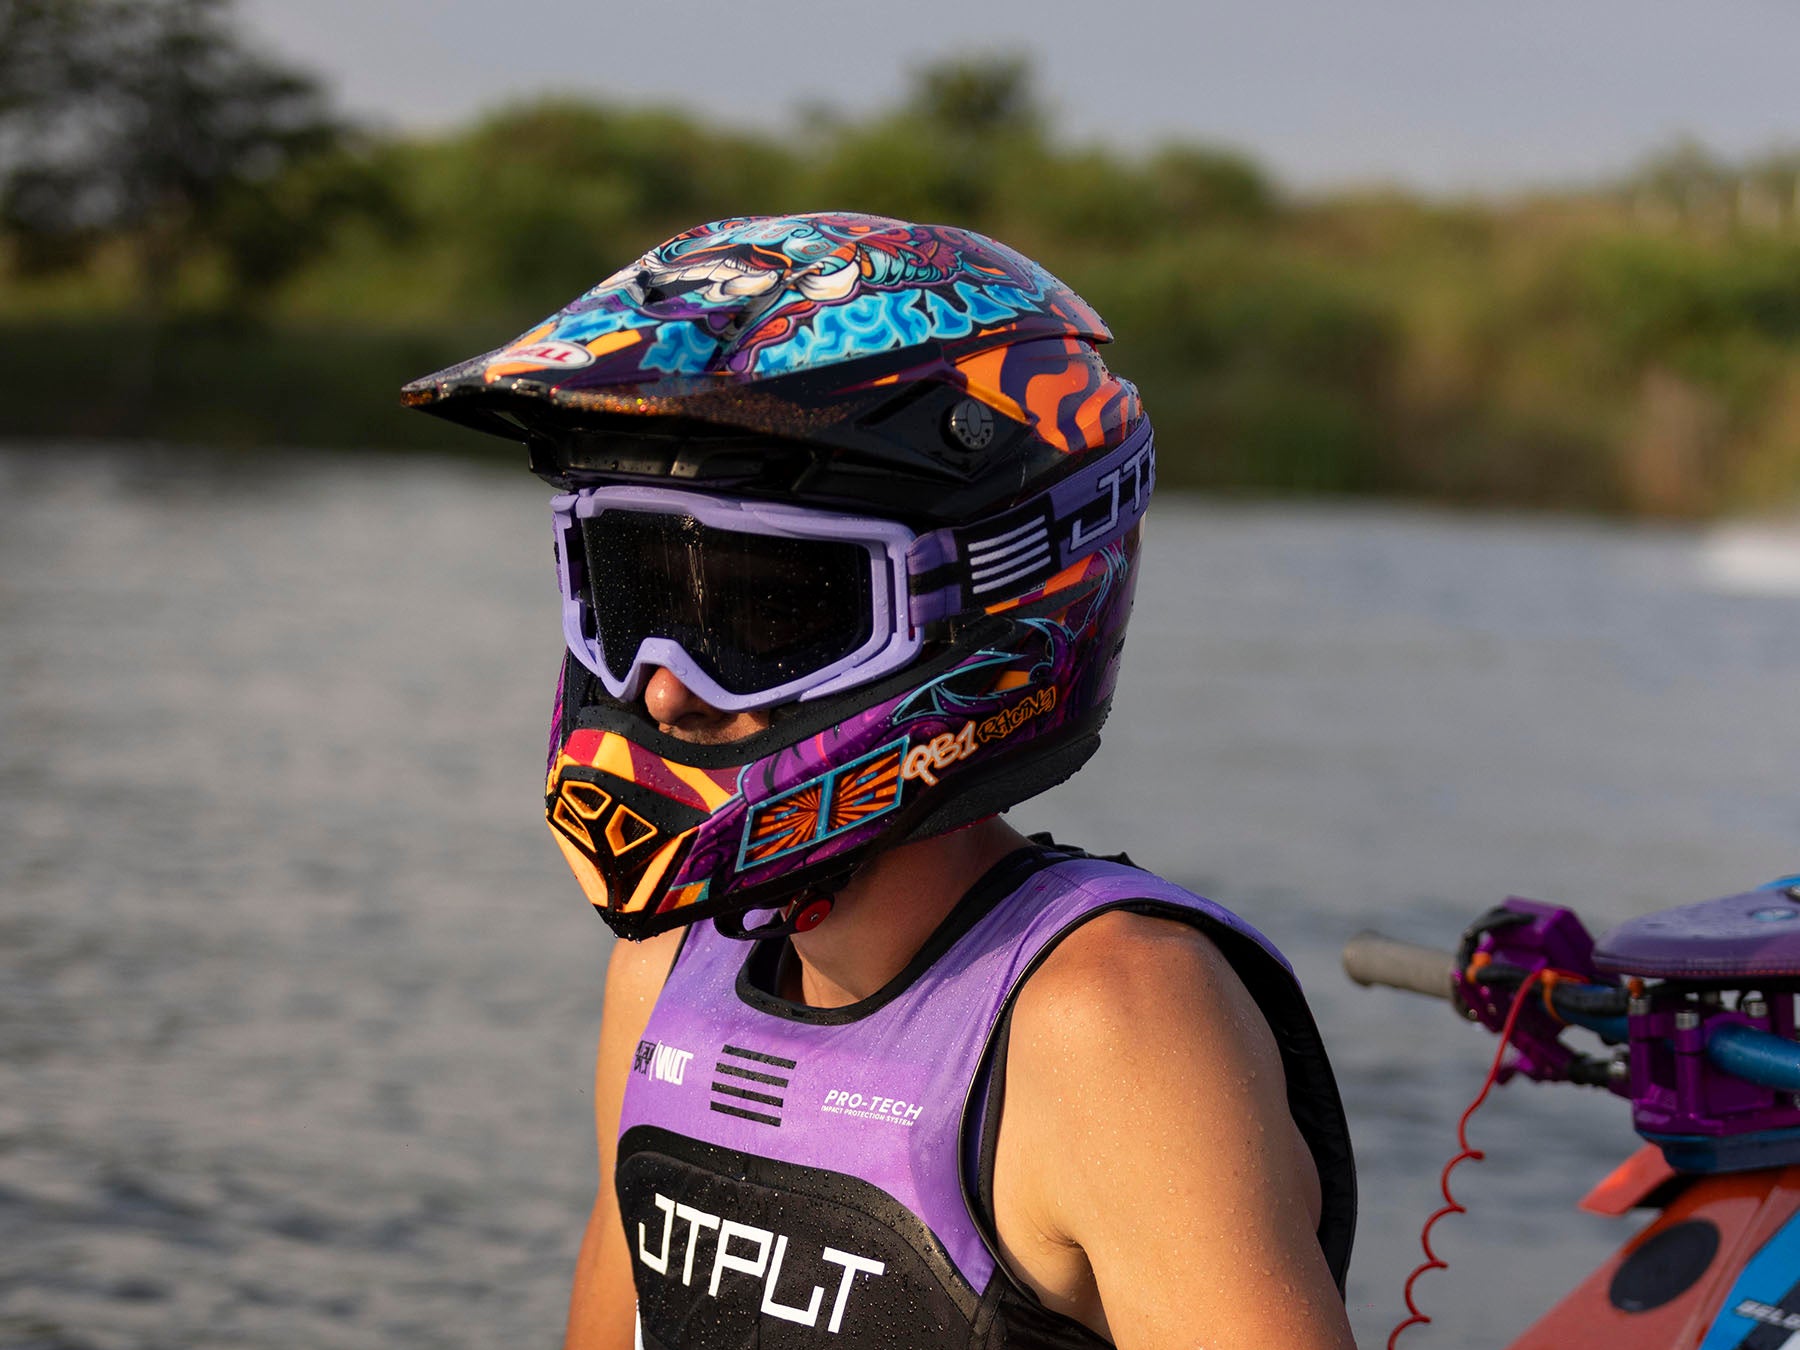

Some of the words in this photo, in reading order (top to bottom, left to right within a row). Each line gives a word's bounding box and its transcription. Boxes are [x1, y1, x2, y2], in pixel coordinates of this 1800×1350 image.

[821, 1104, 843, 1114] IMPACT
[843, 1108, 885, 1121] PROTECTION
[886, 1115, 914, 1127] SYSTEM
[824, 1089, 924, 1120] PRO-TECH
[638, 1193, 885, 1333] JTPLT
